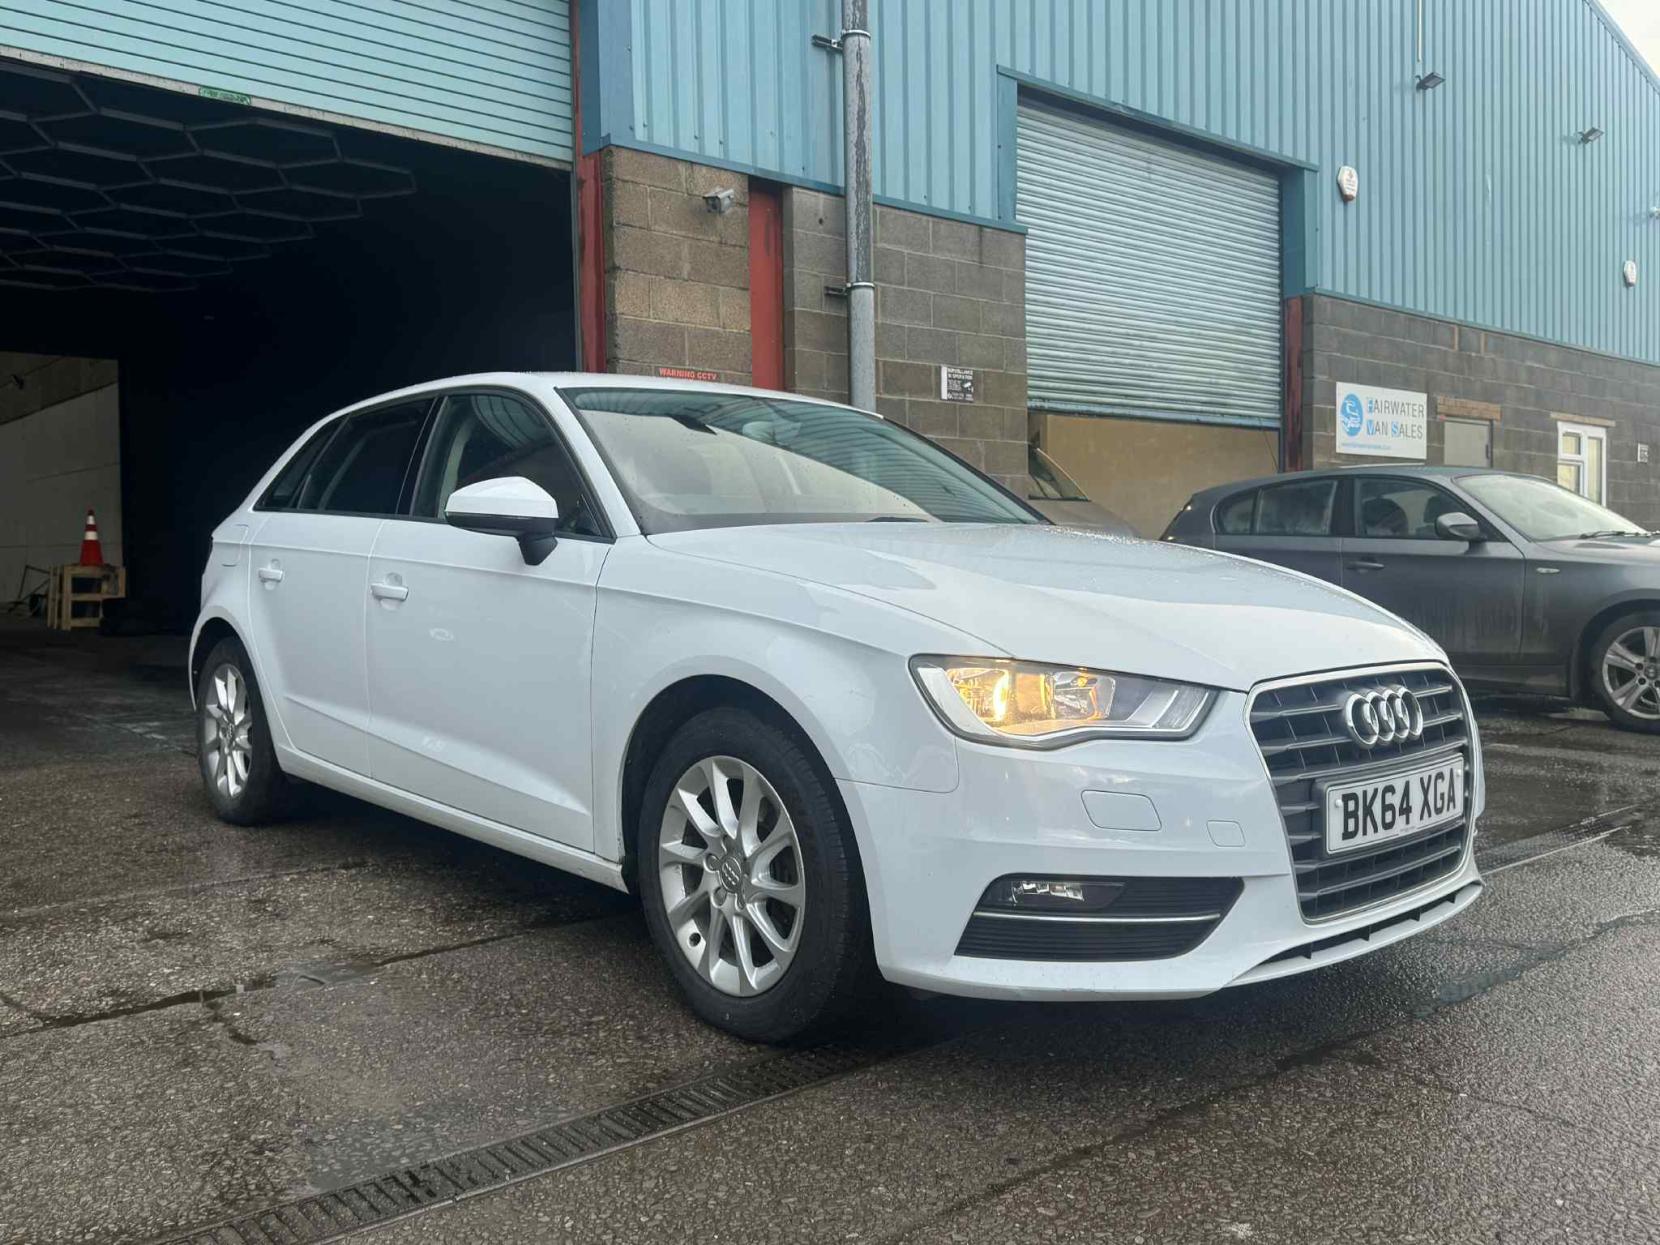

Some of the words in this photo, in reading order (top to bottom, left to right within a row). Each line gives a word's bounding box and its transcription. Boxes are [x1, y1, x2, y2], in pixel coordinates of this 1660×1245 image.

[659, 367, 695, 379] WARNING
[696, 372, 717, 381] CCTV
[1367, 399, 1425, 418] FAIRWATER
[1366, 420, 1388, 436] VAN
[1391, 421, 1423, 439] SALES
[1341, 780, 1412, 841] BK64
[1419, 767, 1456, 821] XGA
